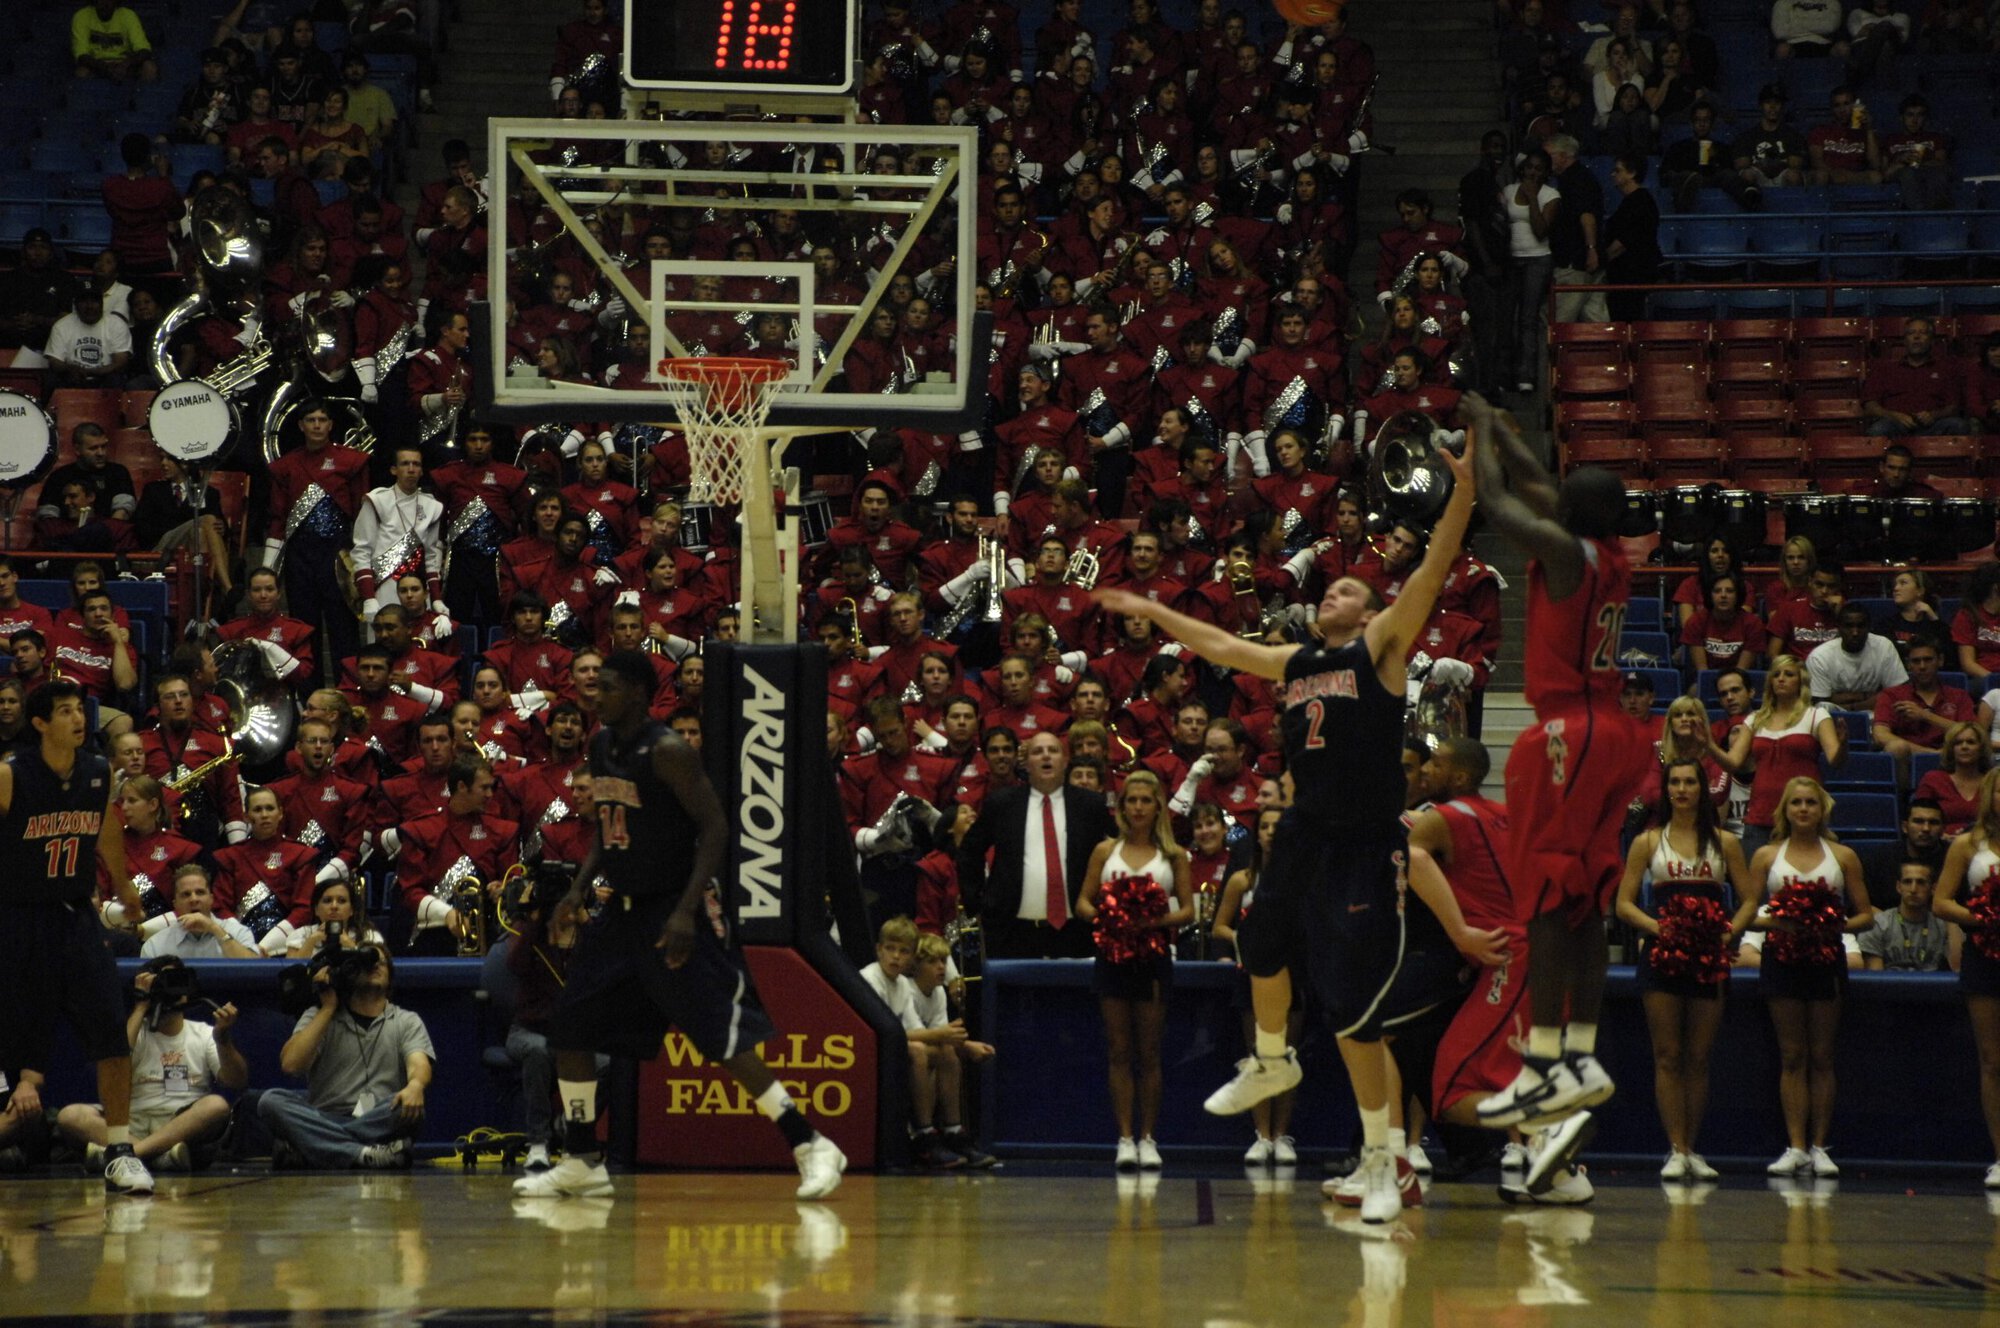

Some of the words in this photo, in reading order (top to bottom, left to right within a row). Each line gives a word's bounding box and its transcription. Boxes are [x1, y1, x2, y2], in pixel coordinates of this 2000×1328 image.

[715, 0, 796, 70] 18
[172, 393, 211, 408] YAMAHA
[1305, 699, 1325, 750] 2
[739, 662, 786, 918] ARIZONA
[22, 810, 100, 839] ARIZONA
[45, 836, 80, 878] 11
[663, 1032, 857, 1070] WLLS
